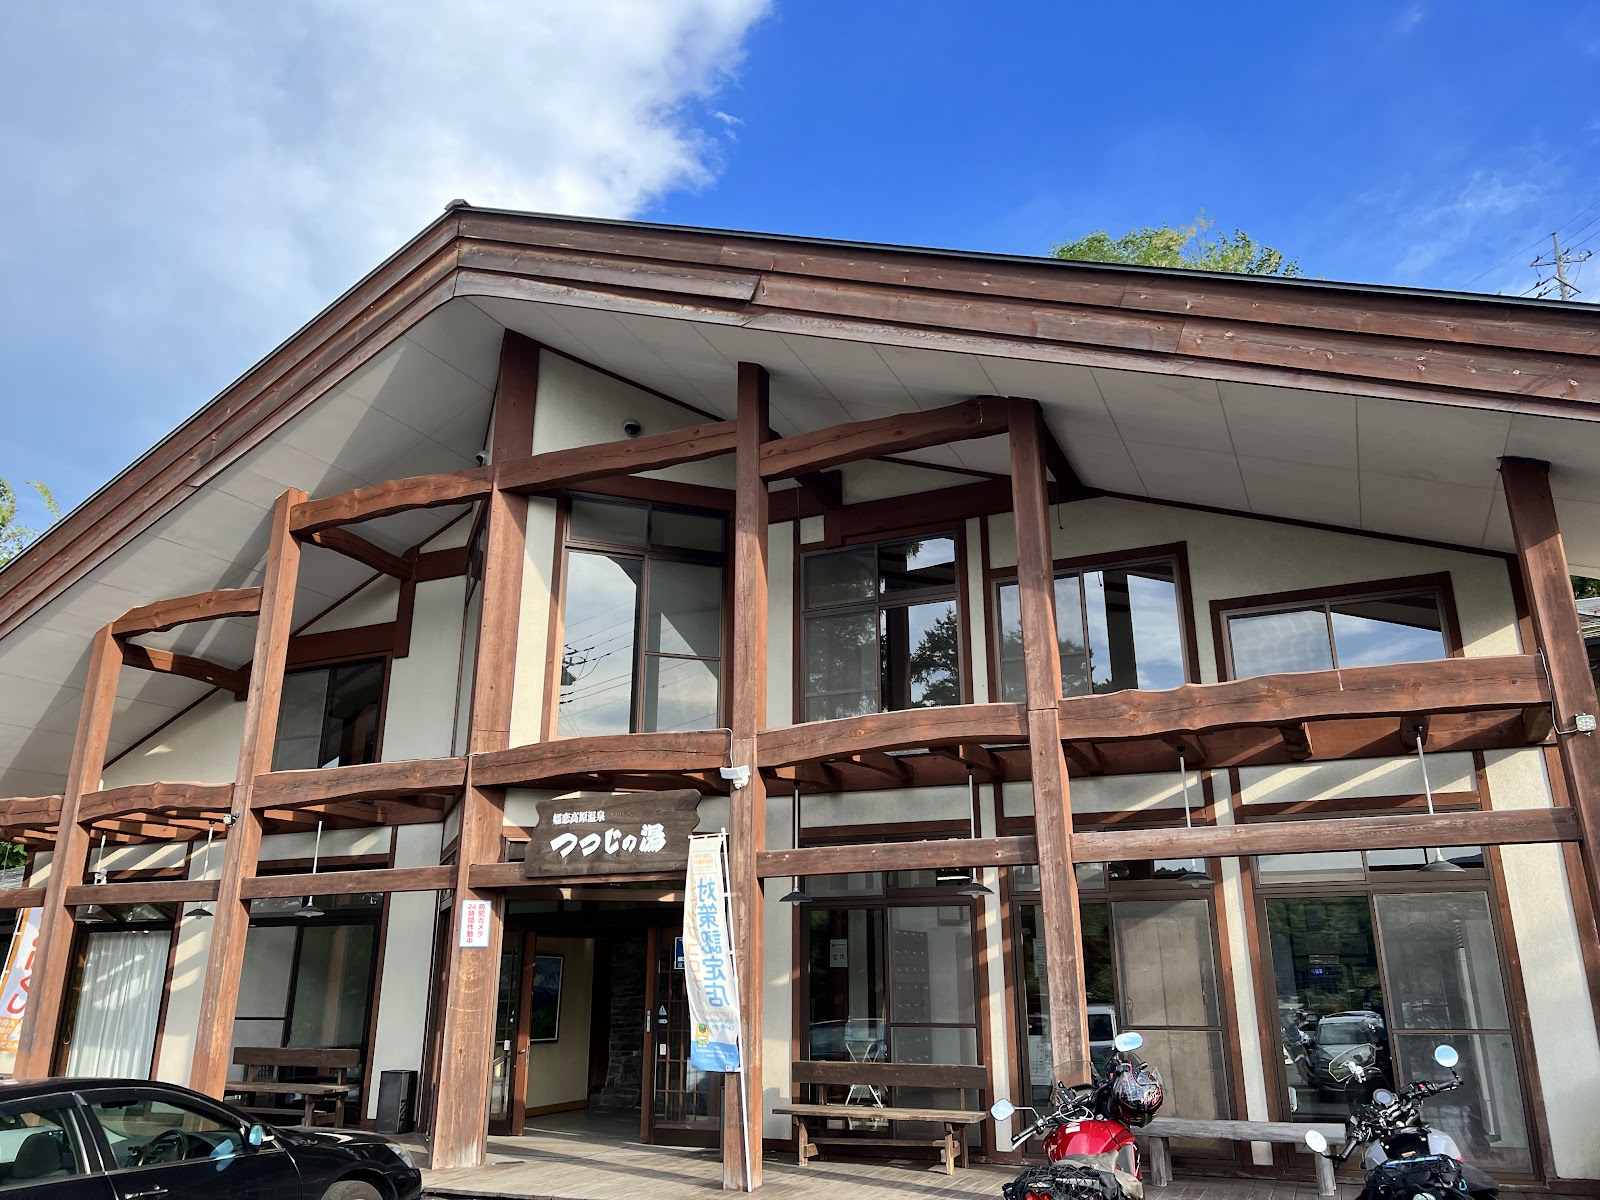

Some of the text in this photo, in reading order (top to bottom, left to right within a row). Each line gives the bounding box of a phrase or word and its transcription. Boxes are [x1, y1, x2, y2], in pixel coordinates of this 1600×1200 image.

[550, 823, 667, 858] つつじの湯
[466, 903, 476, 944] 24時間作動中
[477, 903, 486, 938] 防犯カメラ
